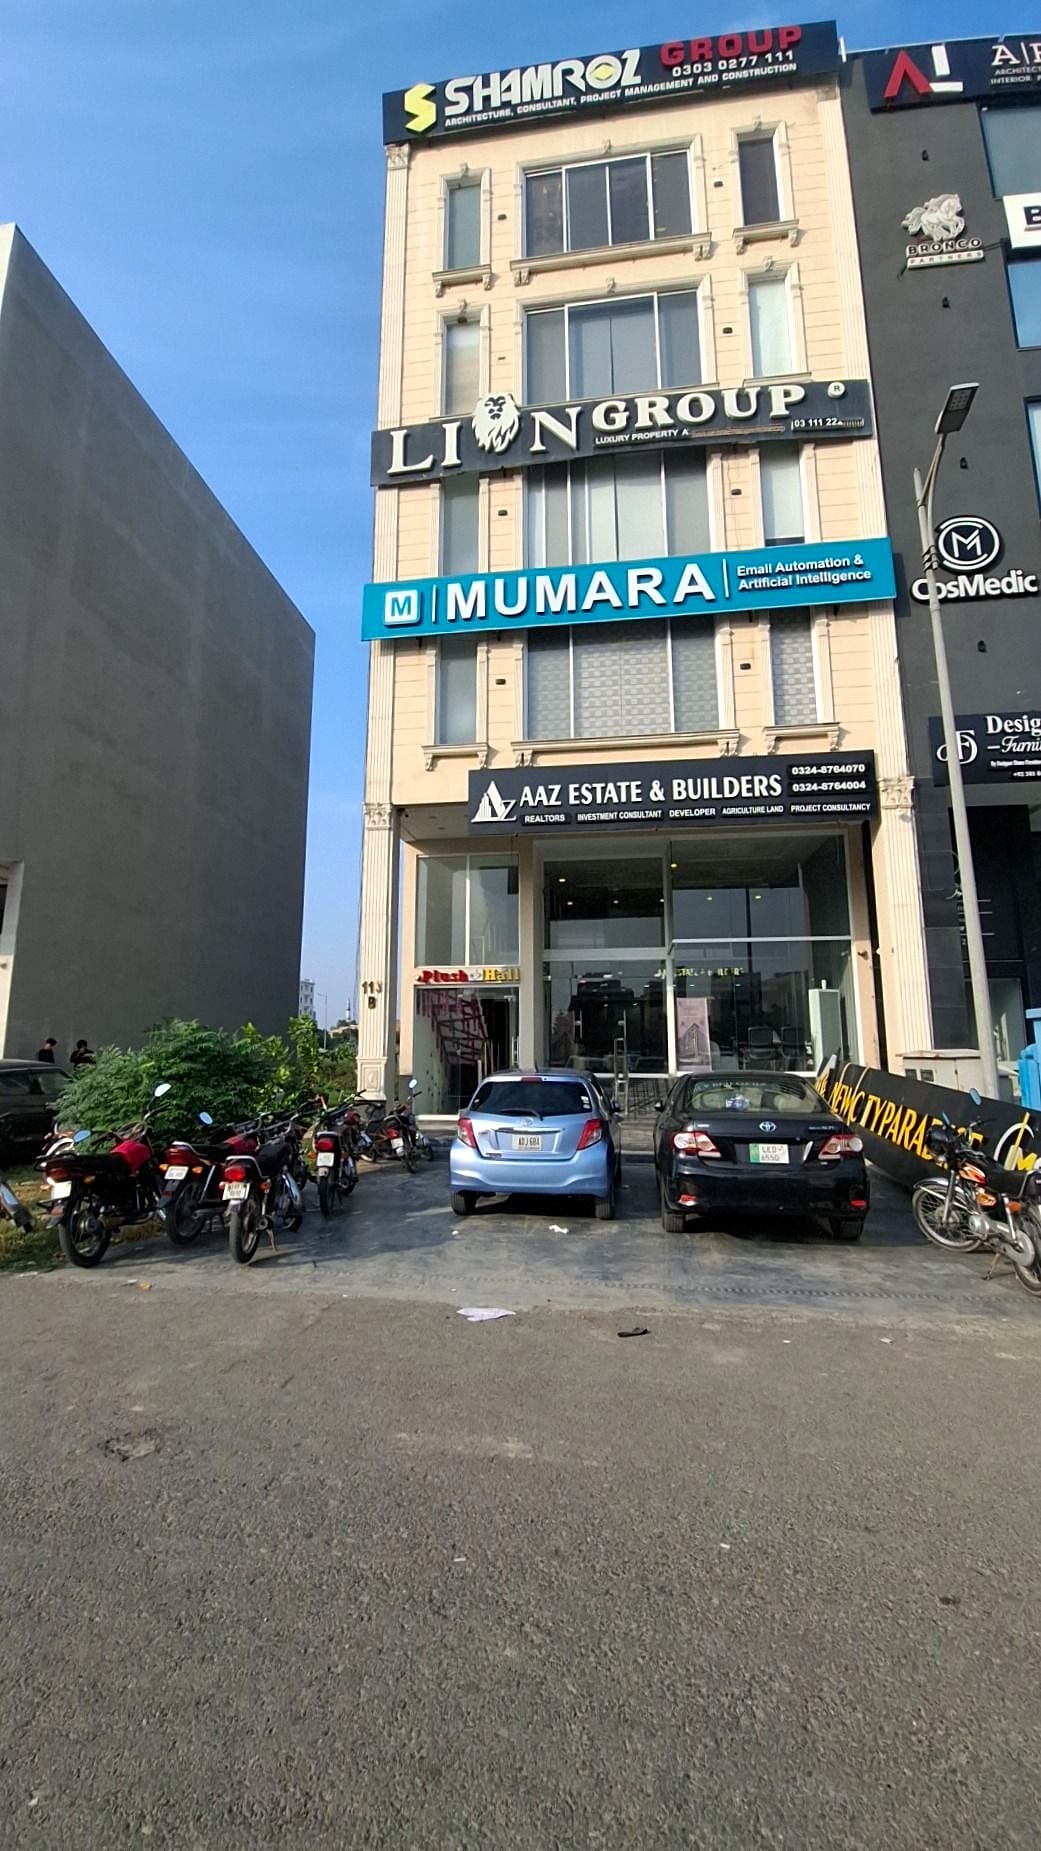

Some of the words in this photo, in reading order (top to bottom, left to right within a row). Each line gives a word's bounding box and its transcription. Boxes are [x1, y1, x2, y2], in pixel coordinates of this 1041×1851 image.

[660, 25, 802, 67] GROUP
[672, 60, 713, 77] 0303
[718, 55, 759, 71] 0277
[765, 50, 794, 65] 111
[445, 108, 514, 127] ARCHITECTURE,
[517, 97, 577, 114] CONSULTANT,
[580, 89, 622, 105] PROJECT
[624, 79, 694, 97] MANAGEMENT
[697, 74, 719, 85] AND
[722, 63, 797, 81] CONSTRUCTION
[906, 237, 982, 257] BRONCO
[592, 384, 806, 432] GROUP
[595, 433, 630, 445] LUXURY
[631, 429, 679, 441] PROPERTY
[737, 562, 772, 577] Email
[775, 557, 850, 573] Automation
[853, 554, 864, 565] &
[447, 563, 716, 622] MUMARA
[738, 575, 793, 591] Artificial
[796, 569, 872, 586] Intelligence
[519, 784, 562, 807] AAZ
[568, 781, 642, 805] ESTATE
[649, 779, 665, 802] &
[672, 774, 783, 801] BUILDERS
[524, 813, 566, 824] REALTORS
[577, 812, 618, 822] INVESTMENT
[618, 810, 662, 820] CONSULTANT
[668, 807, 716, 818] DEVELOPER
[722, 806, 765, 816] AGRICULTURE
[766, 805, 784, 814] LAND
[790, 804, 821, 813] PROJECT
[822, 802, 871, 812] CONSULTANCY
